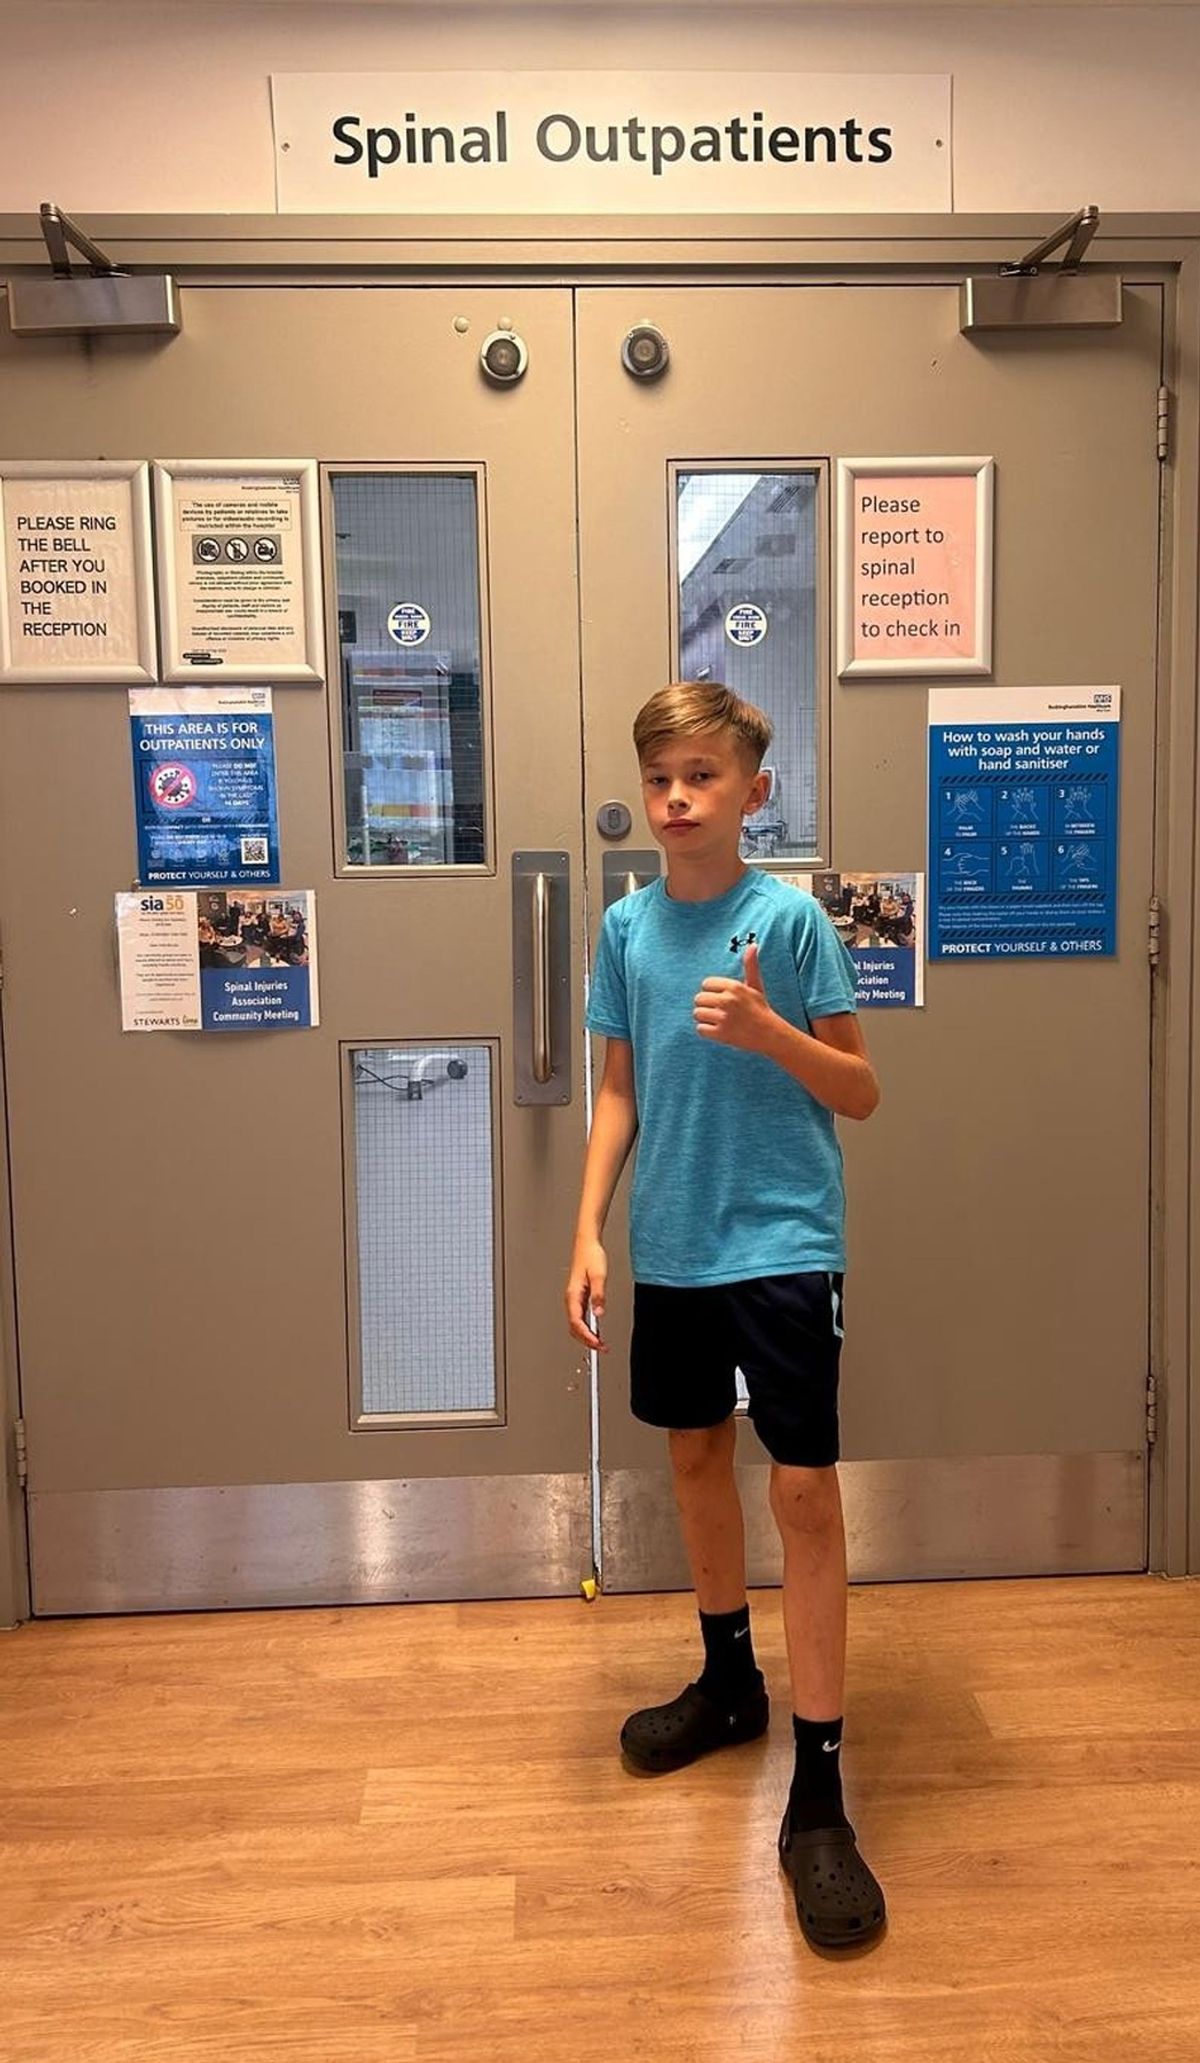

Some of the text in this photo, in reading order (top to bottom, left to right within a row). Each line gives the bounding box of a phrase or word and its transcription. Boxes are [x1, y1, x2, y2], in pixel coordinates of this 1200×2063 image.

[332, 112, 893, 178] Spinal Outpatients
[862, 496, 920, 512] Please
[17, 516, 116, 530] PLEASE RING
[18, 538, 91, 551] THE BELL
[862, 528, 944, 548] report to
[20, 560, 105, 572] AFTER YOU
[861, 558, 914, 578] spinal
[21, 581, 107, 594] BOOKED IN
[862, 590, 949, 609] reception
[21, 602, 52, 615] THE
[23, 623, 107, 636] RECEPTION
[862, 620, 960, 637] to check in
[144, 722, 258, 735] THIS AREA IS FOR
[943, 729, 1105, 744] How to wash your hands
[140, 738, 265, 751] OUTPATIENTS ONLY
[948, 744, 1099, 758] with soap and water or
[978, 758, 1069, 770] hand sanitiser
[1001, 847, 1007, 855] 5
[1058, 845, 1064, 854] 6
[148, 872, 186, 880] PROTECT
[141, 896, 184, 911] sia 50
[942, 940, 1102, 953] PROTECT YOURSELF & OTHERS
[863, 961, 895, 972] Injuries
[224, 981, 287, 993] Spinal Injuries
[857, 976, 889, 985] ciation
[872, 989, 906, 1000] Meeting
[232, 997, 282, 1006] Association
[213, 1010, 299, 1022] Community Meeting
